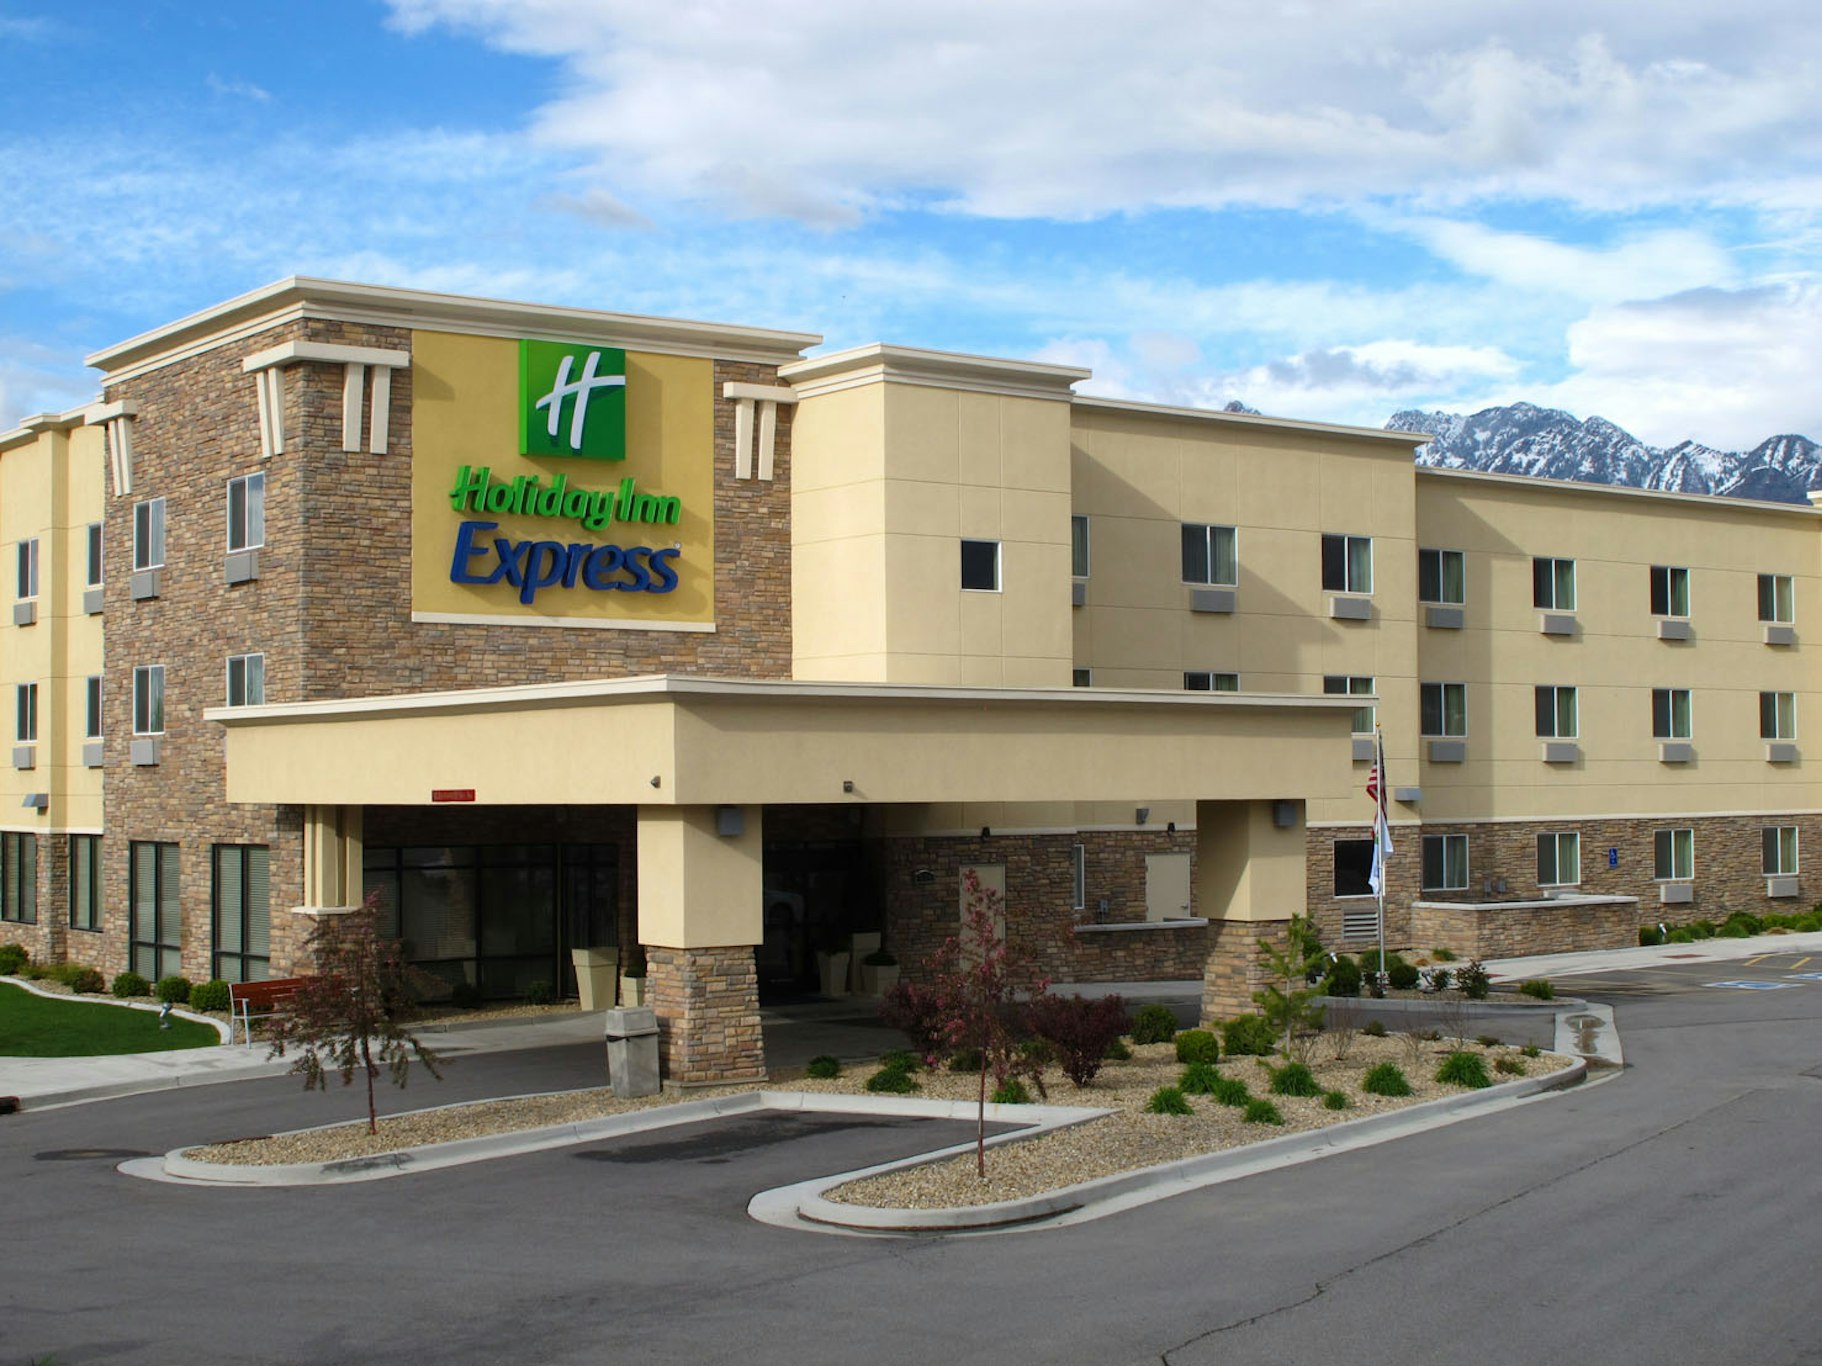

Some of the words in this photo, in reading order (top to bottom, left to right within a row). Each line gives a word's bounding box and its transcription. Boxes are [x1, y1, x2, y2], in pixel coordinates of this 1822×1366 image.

[536, 351, 625, 449] H
[449, 465, 614, 530] Holiday
[617, 478, 681, 524] Inn
[450, 521, 680, 604] Express
